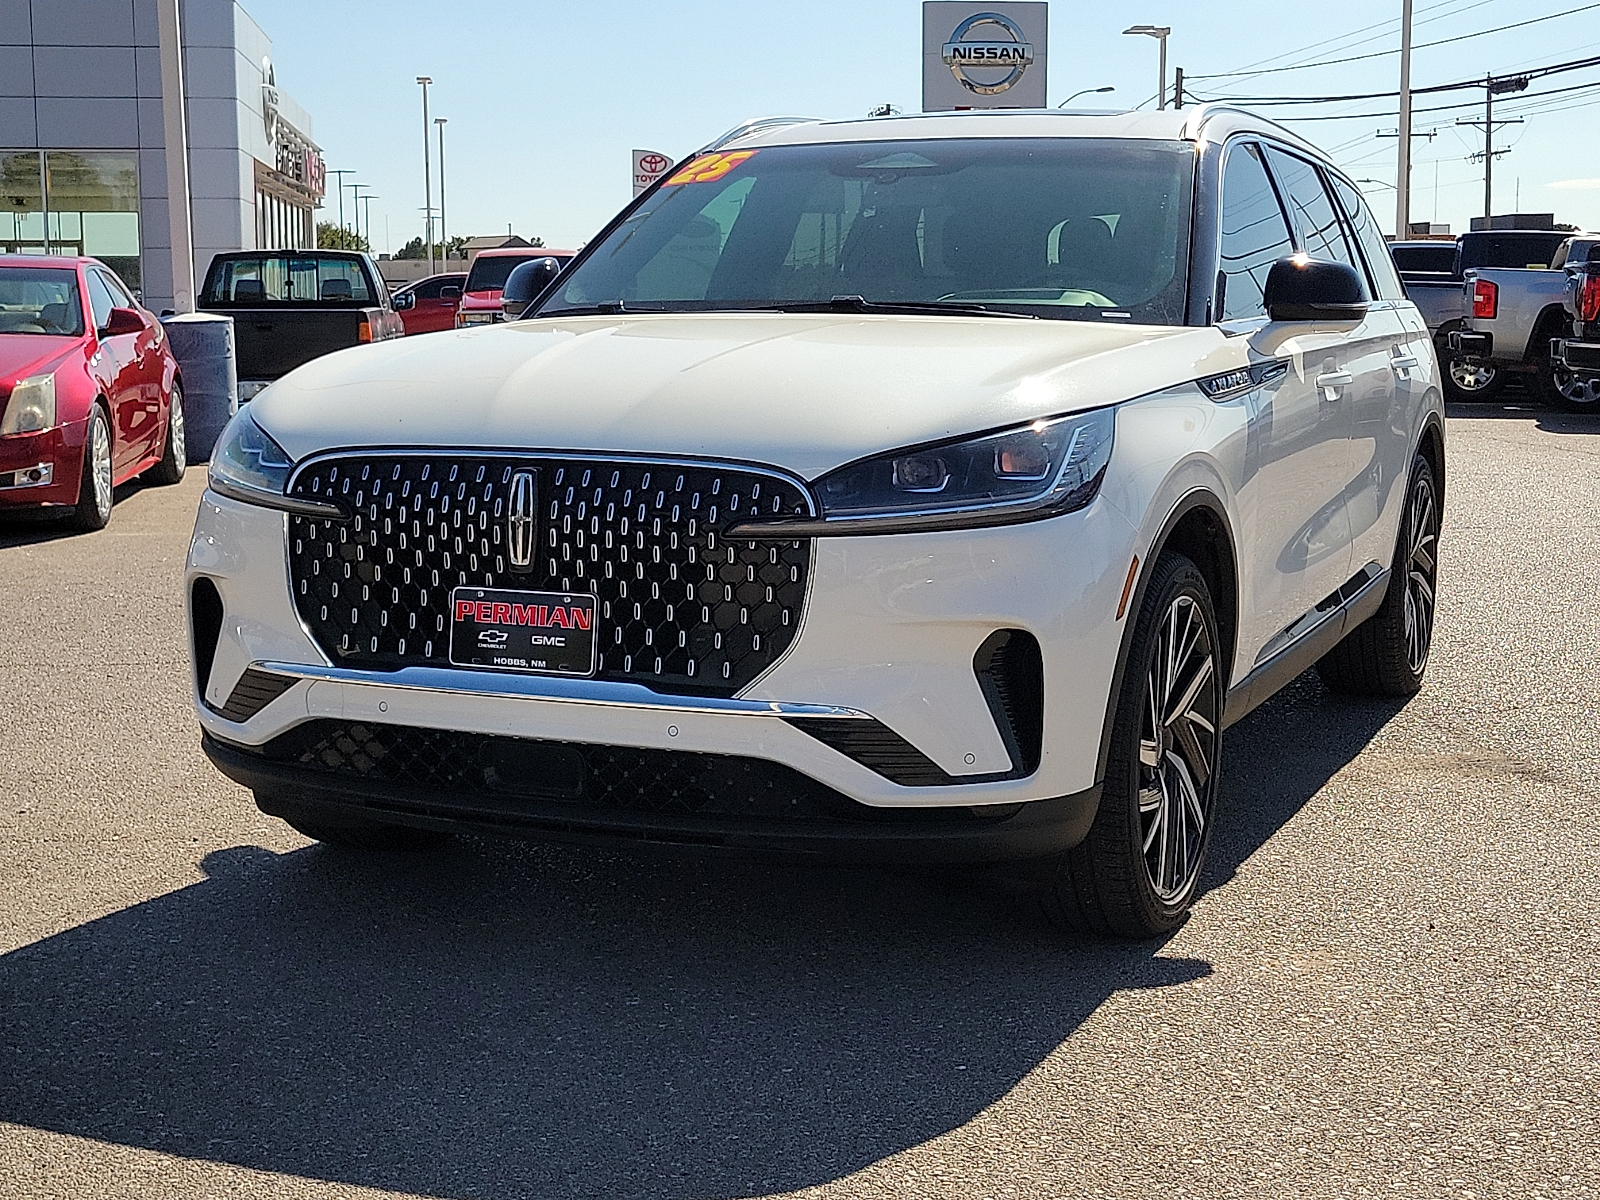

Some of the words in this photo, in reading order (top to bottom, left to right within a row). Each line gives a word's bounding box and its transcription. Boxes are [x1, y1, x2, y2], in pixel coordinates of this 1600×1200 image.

[952, 46, 1025, 60] NISSAN
[668, 151, 754, 185] 25
[455, 599, 592, 631] PERMIAN
[531, 635, 566, 647] GMC
[493, 656, 529, 668] HOBBS,
[531, 659, 546, 668] NM
